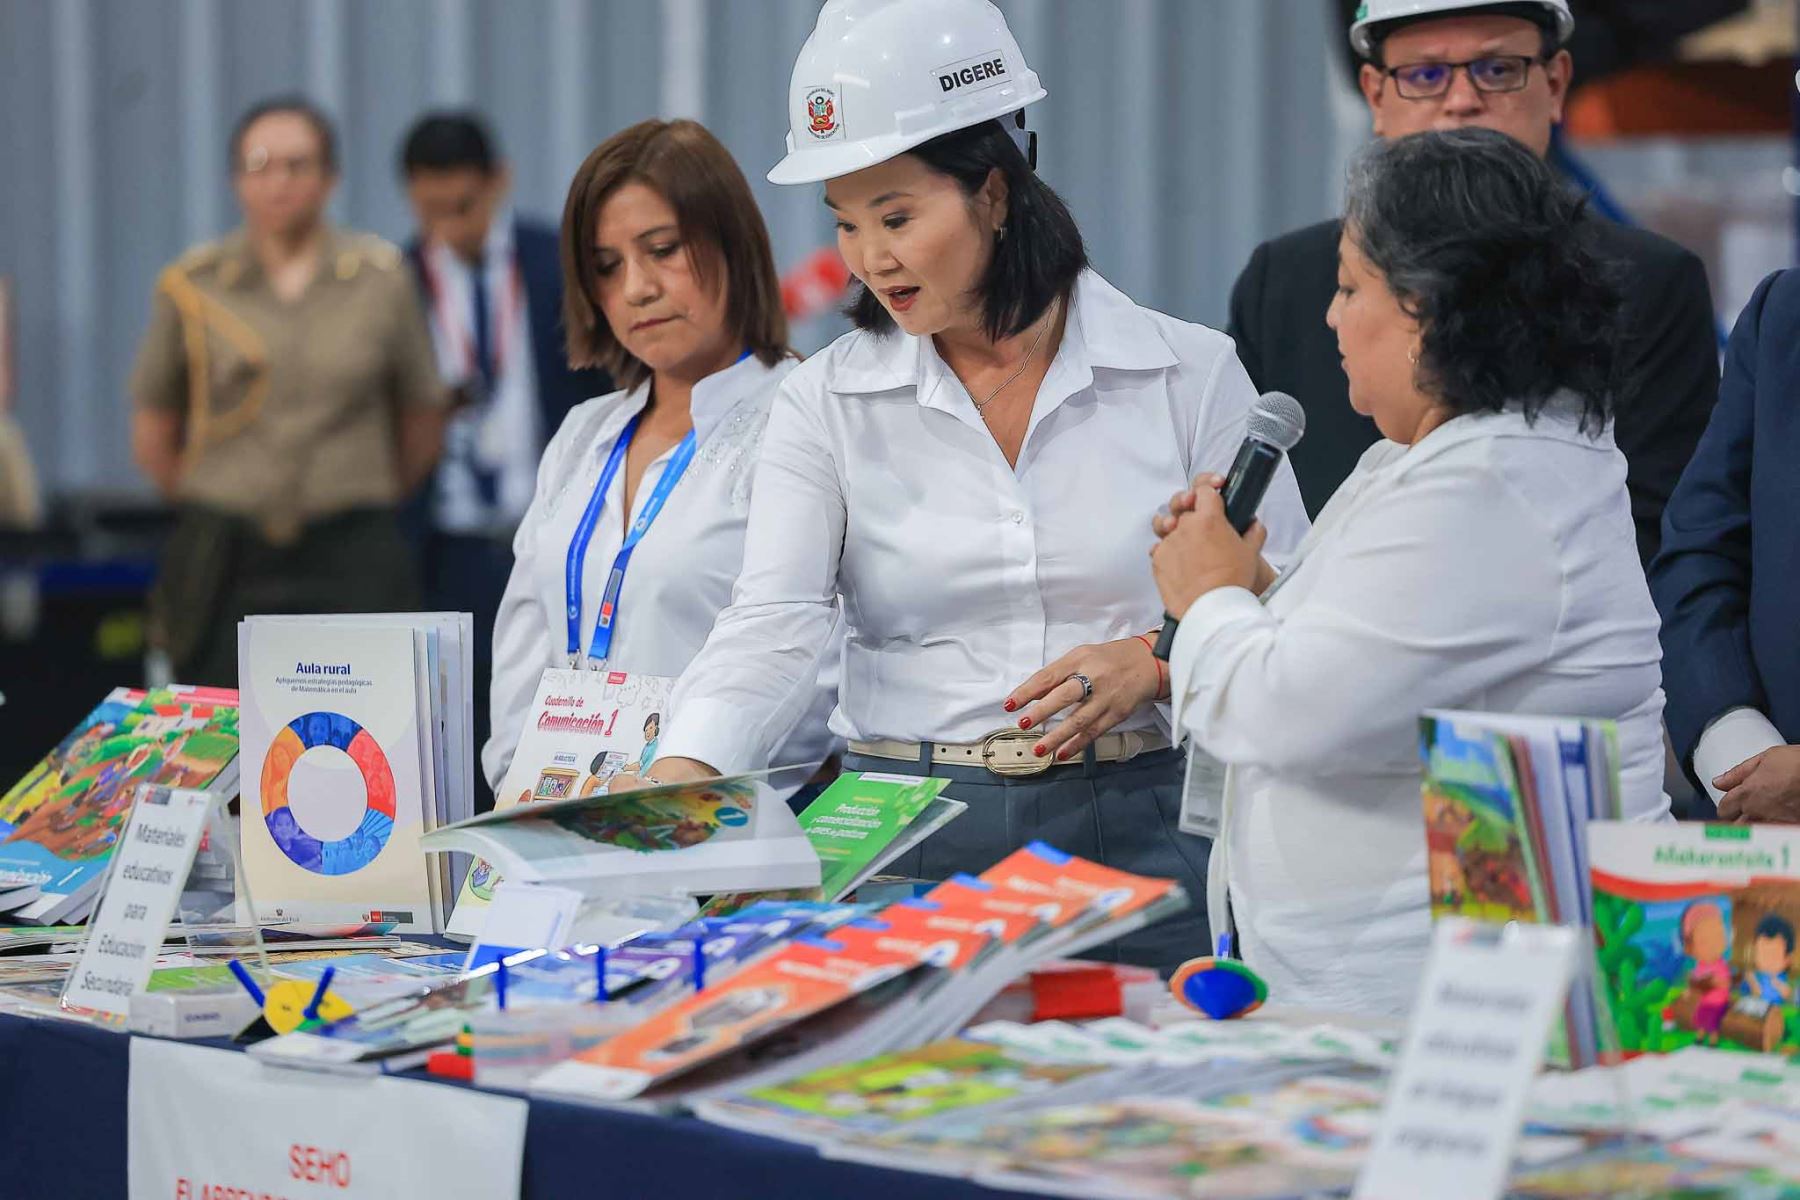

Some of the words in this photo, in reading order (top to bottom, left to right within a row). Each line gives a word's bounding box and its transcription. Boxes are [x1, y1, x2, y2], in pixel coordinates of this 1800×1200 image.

[939, 58, 1006, 92] DIGERE
[295, 662, 321, 674] Aula
[323, 664, 351, 675] rural
[545, 695, 575, 707] Cuadernillo
[575, 697, 584, 707] de
[538, 710, 604, 733] Comunicación
[604, 708, 619, 736] 1
[134, 822, 188, 849] Materiales
[122, 861, 174, 886] educativos
[123, 903, 148, 922] para
[288, 1144, 350, 1189] SEHO
